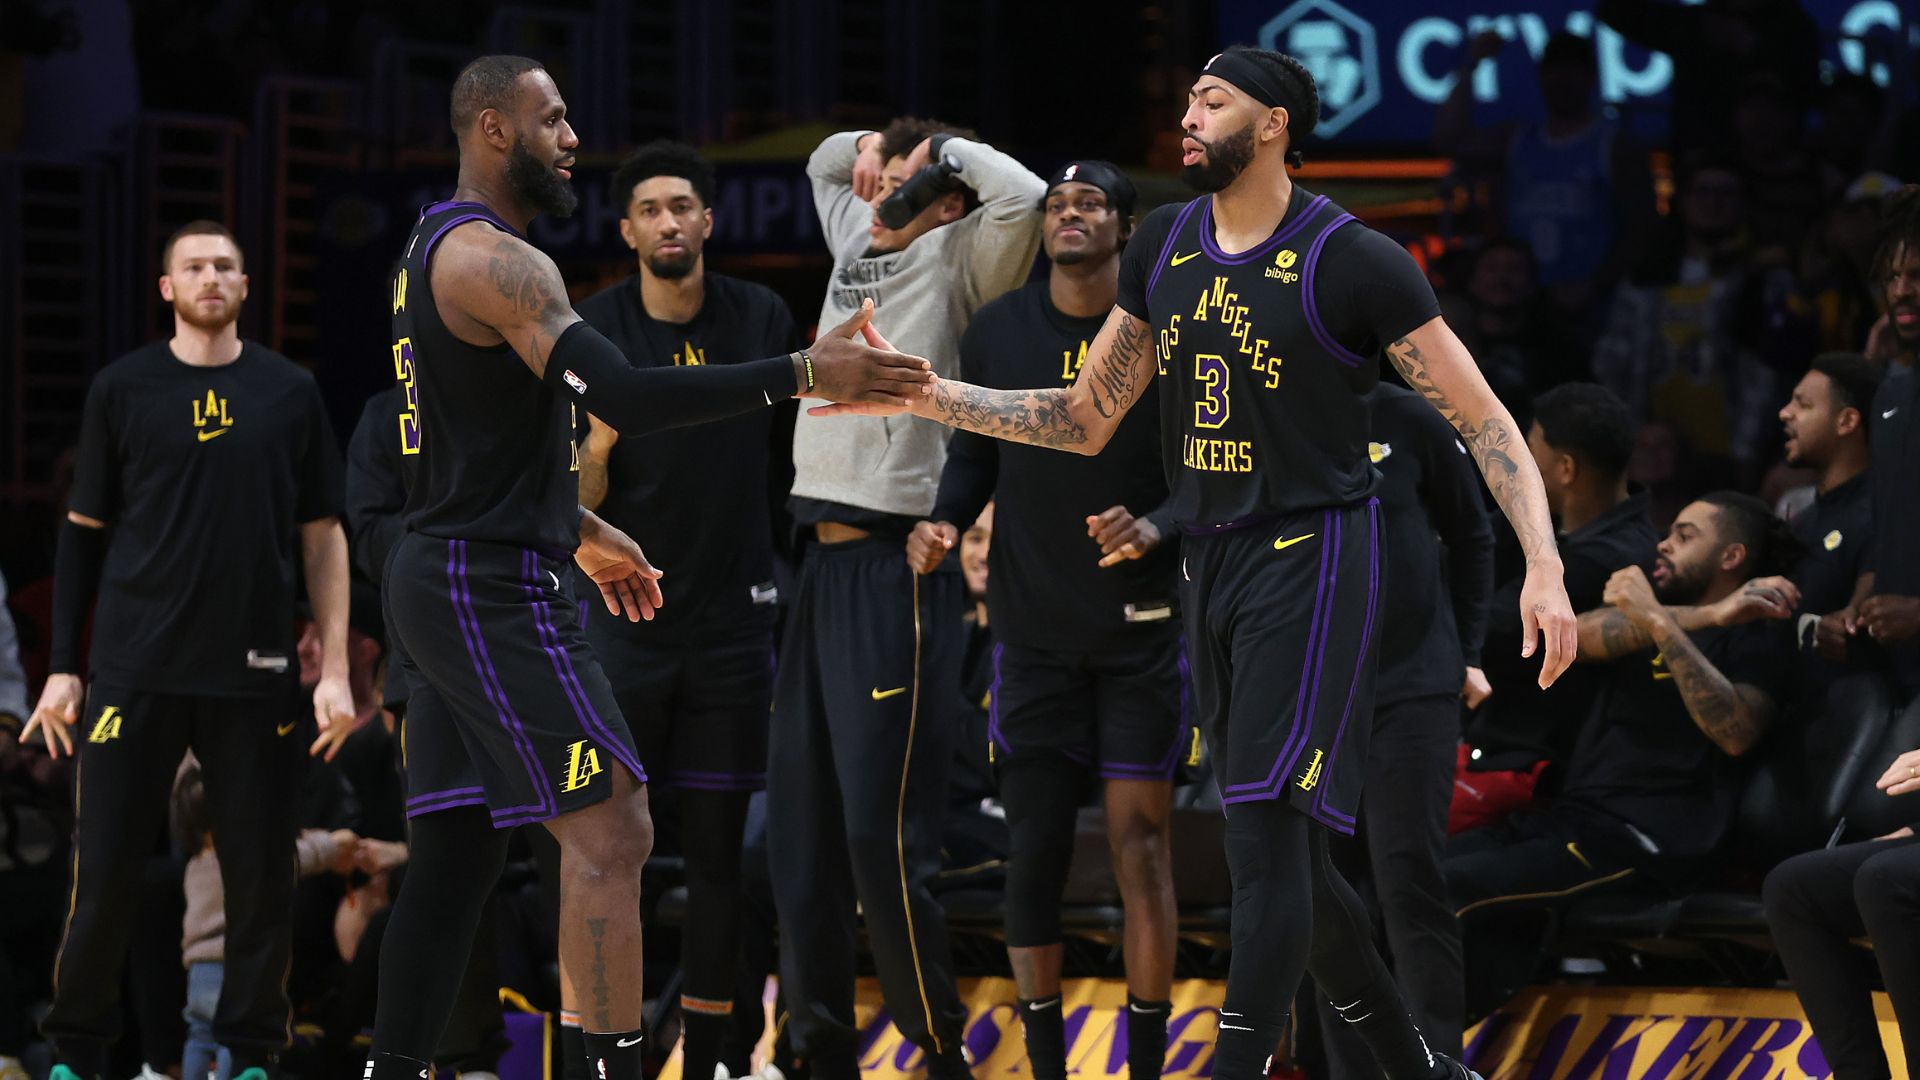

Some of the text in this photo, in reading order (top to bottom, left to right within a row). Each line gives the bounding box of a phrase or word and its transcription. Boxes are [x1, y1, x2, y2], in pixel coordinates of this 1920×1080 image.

[1264, 266, 1299, 284] bibigo
[1156, 276, 1282, 389] LOS ANGELES
[192, 388, 234, 427] LAL
[1194, 353, 1230, 429] 3
[1183, 434, 1252, 473] LAKERS
[559, 739, 604, 793] LA
